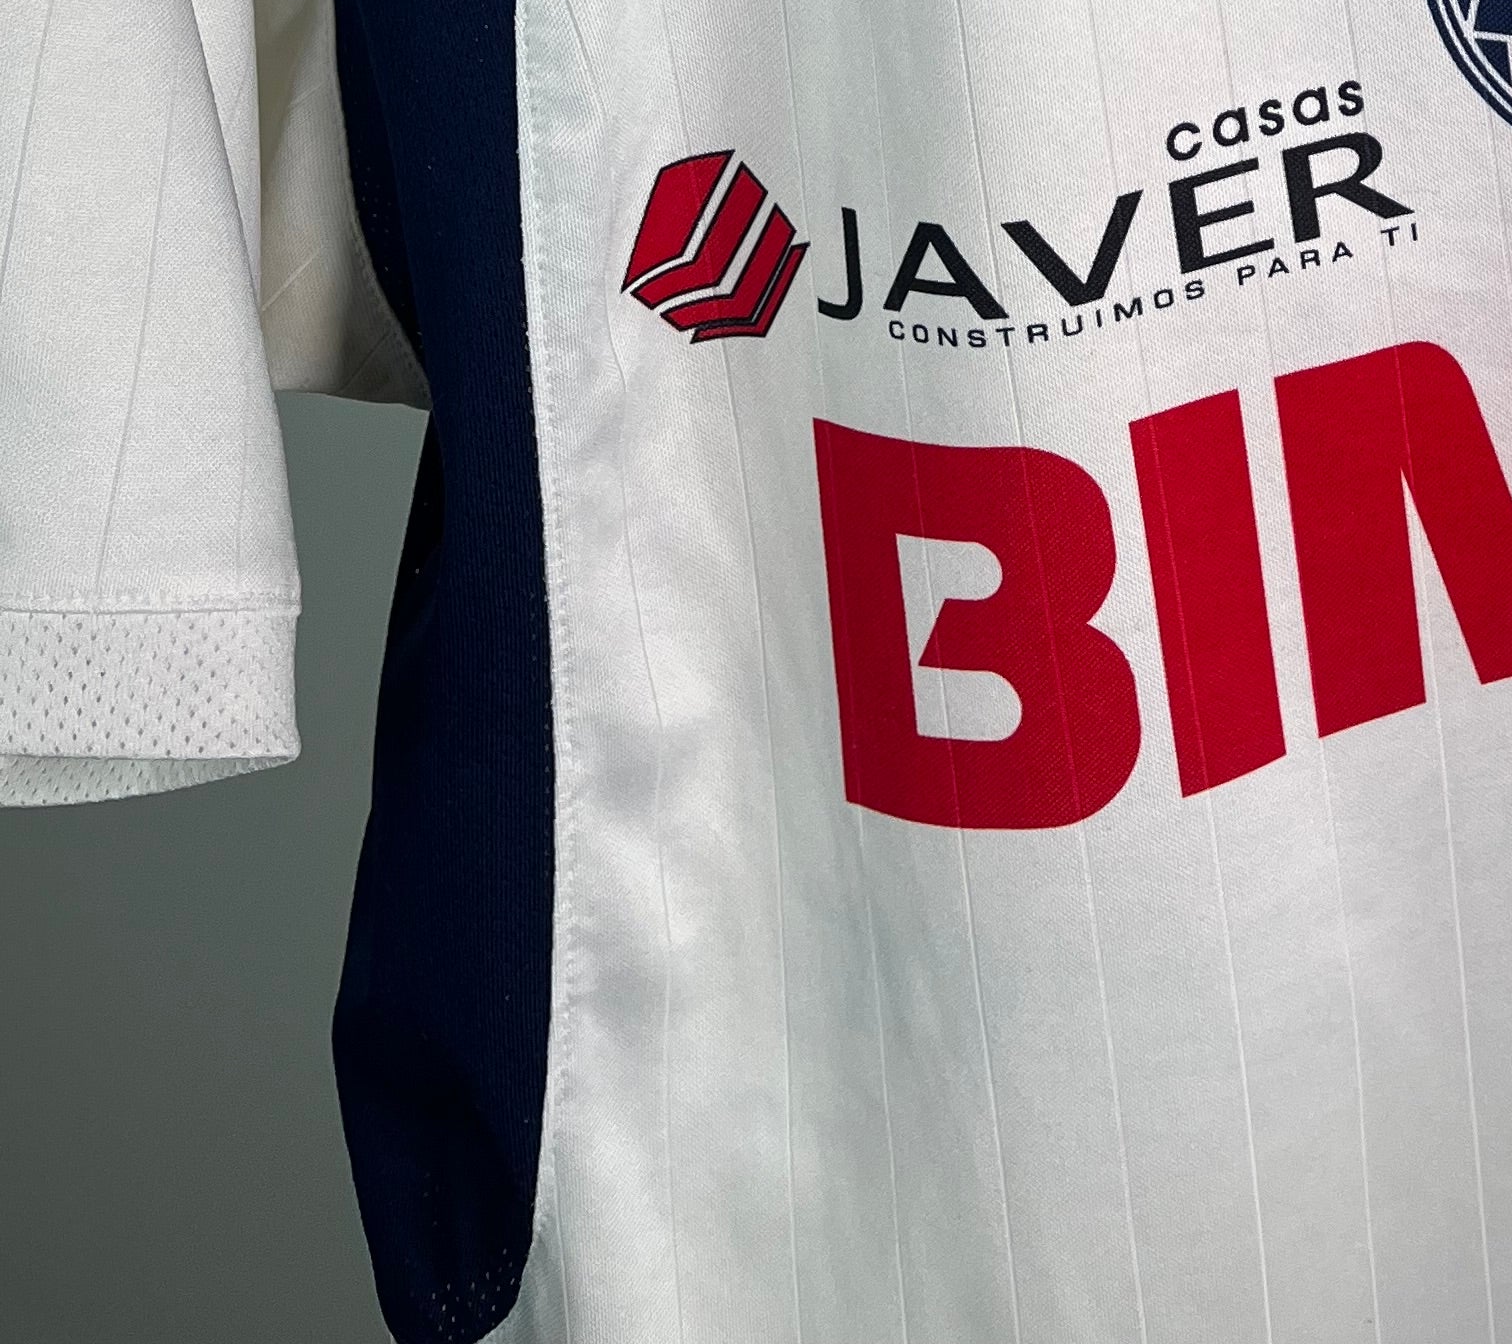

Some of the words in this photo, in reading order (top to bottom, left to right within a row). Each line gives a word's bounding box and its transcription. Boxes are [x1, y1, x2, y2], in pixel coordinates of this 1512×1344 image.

[1166, 80, 1365, 162] casas
[817, 130, 1416, 322] JAVER
[887, 278, 1206, 349] CONSTRUIMOS
[1236, 241, 1354, 286] PARA
[1380, 222, 1418, 247] TI
